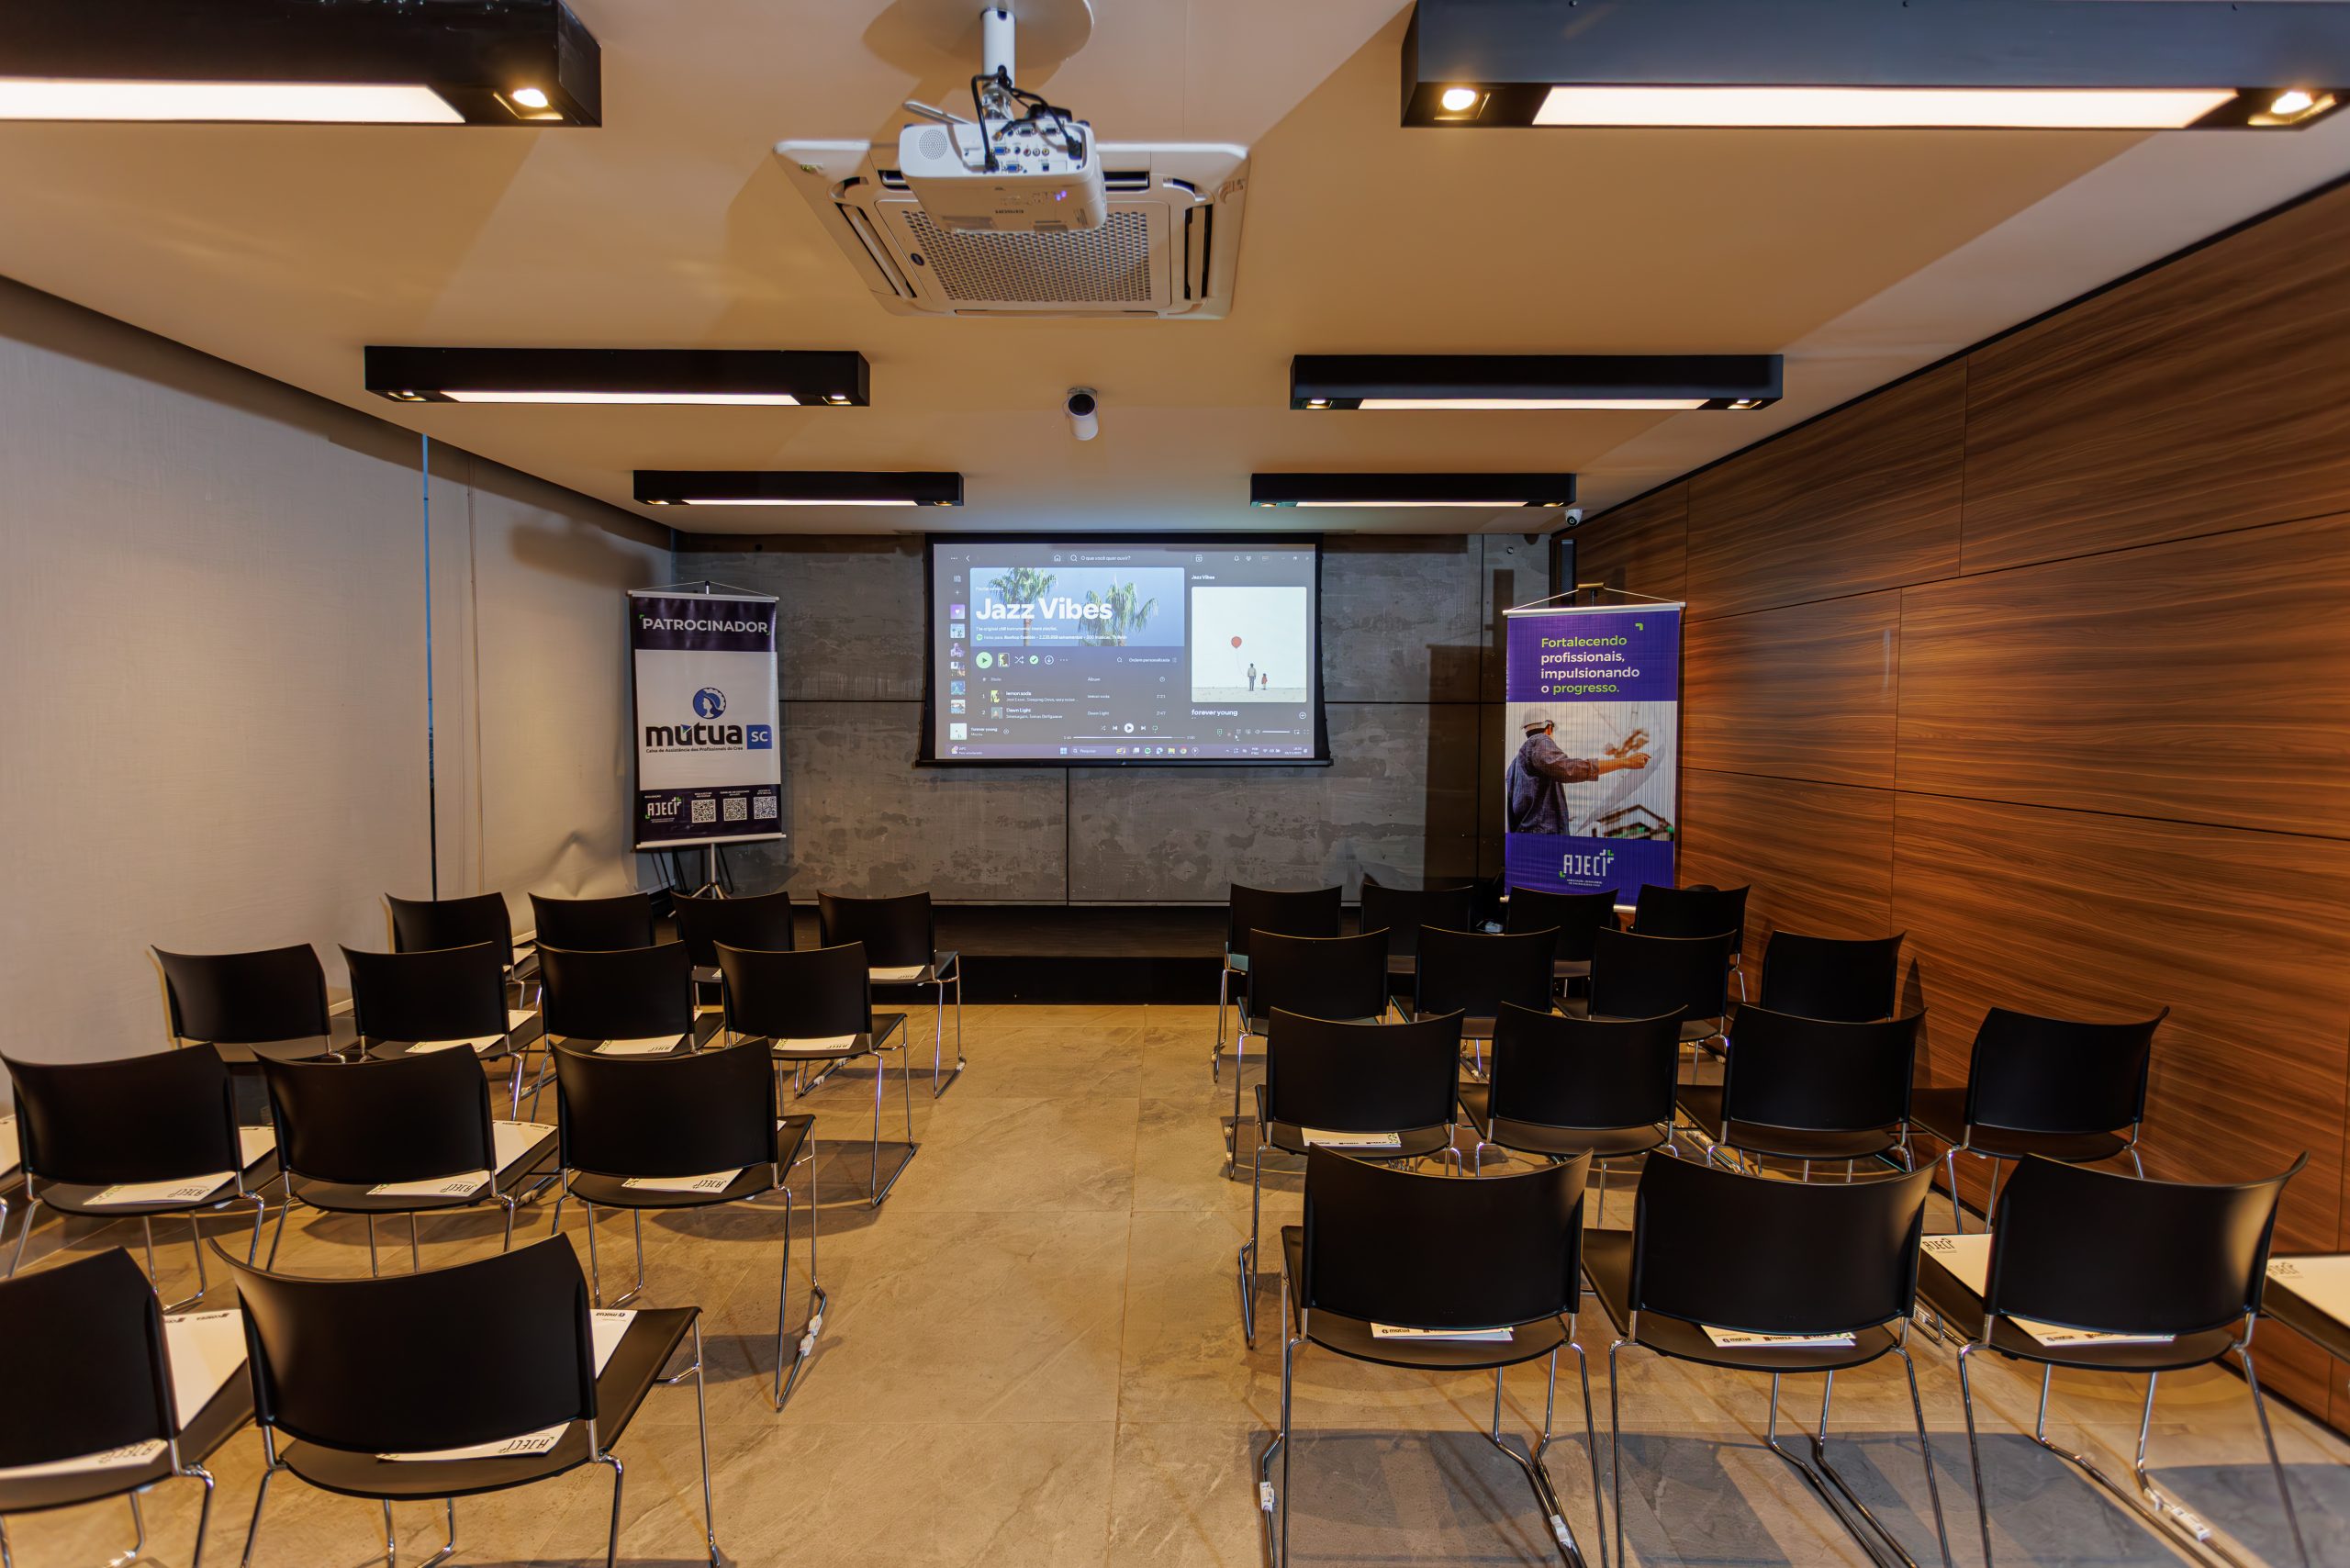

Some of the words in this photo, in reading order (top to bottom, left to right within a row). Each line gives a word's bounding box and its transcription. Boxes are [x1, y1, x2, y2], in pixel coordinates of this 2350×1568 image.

[975, 598, 1035, 621] Jazz
[1037, 597, 1113, 620] Vibes
[643, 618, 768, 633] PATROCINADOR
[1541, 635, 1628, 648] Fortalecendo
[1541, 651, 1625, 666] profissionais,
[1541, 666, 1640, 681] impulsionando
[1540, 685, 1550, 694] o
[1552, 684, 1620, 696] progresso.
[751, 731, 768, 742] SC
[647, 801, 678, 816] AJECI
[1562, 851, 1607, 877] AJECI
[507, 1439, 551, 1451] AJECI
